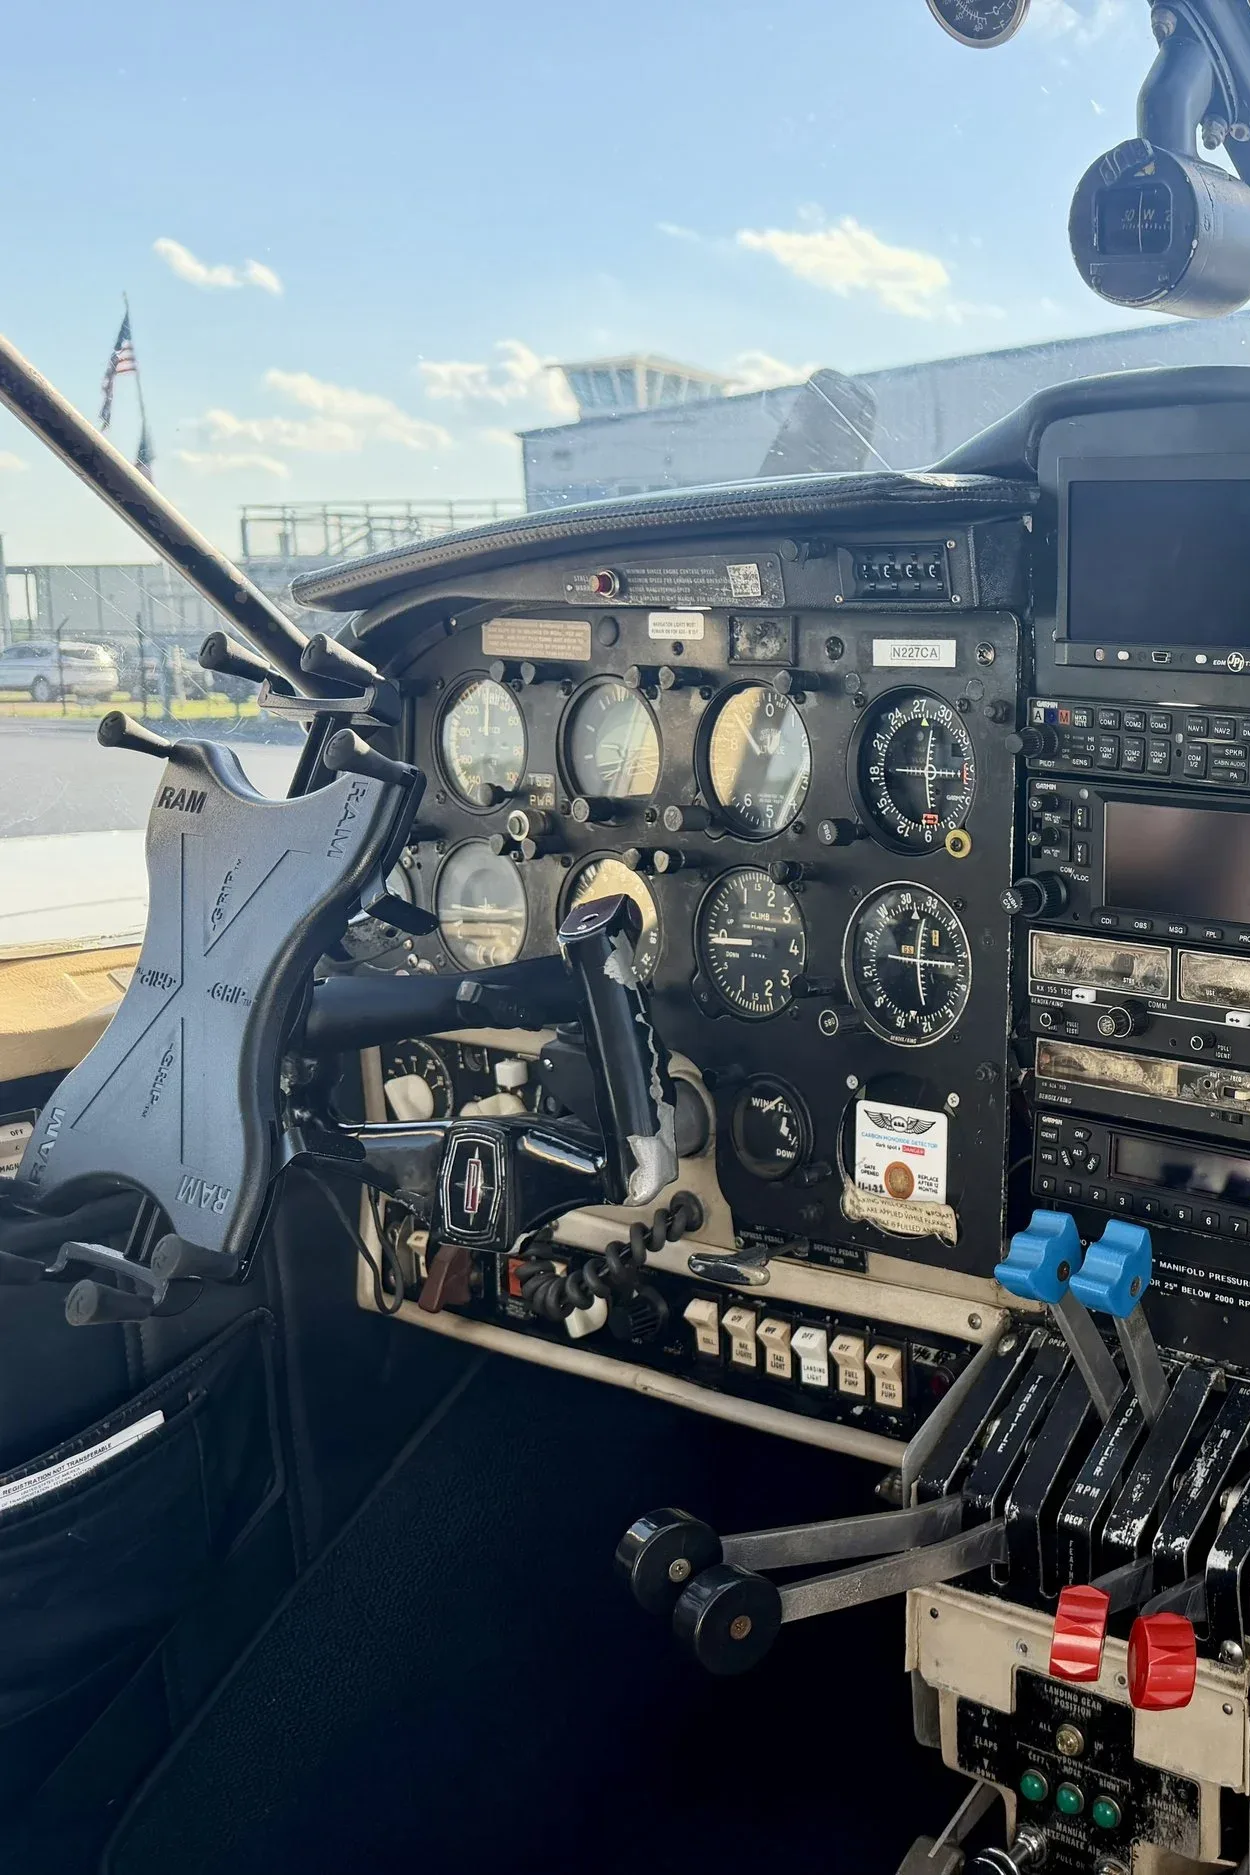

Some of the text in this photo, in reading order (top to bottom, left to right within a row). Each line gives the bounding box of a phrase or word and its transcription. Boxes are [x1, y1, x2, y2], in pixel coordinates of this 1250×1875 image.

[892, 646, 940, 659] N227CA
[912, 699, 926, 712] 27
[937, 705, 952, 721] 30
[1099, 718, 1116, 727] COM1
[1125, 720, 1142, 729] COM2
[1150, 721, 1167, 731] COM3
[1224, 748, 1243, 758] SPKR
[157, 786, 208, 814] RAM
[750, 911, 770, 921] CLIMB
[1169, 924, 1184, 934] MSG
[1148, 1001, 1167, 1011] COMM
[861, 1131, 883, 1140] CARBON
[911, 1139, 938, 1149] DETECTOR
[29, 1106, 67, 1185] RAM
[176, 1174, 232, 1216] RAM
[1159, 1261, 1205, 1279] MANIFOLD
[1181, 1285, 1211, 1300] BELOW
[1214, 1293, 1234, 1305] 2000
[802, 1332, 814, 1340] OFF
[803, 1364, 826, 1374] LANDING
[807, 1372, 822, 1382] LIGHT
[881, 1382, 896, 1392] FUEL
[881, 1390, 896, 1400] PUMP
[2, 1442, 112, 1496] REGISTRATION NOT TRANSFERABLE
